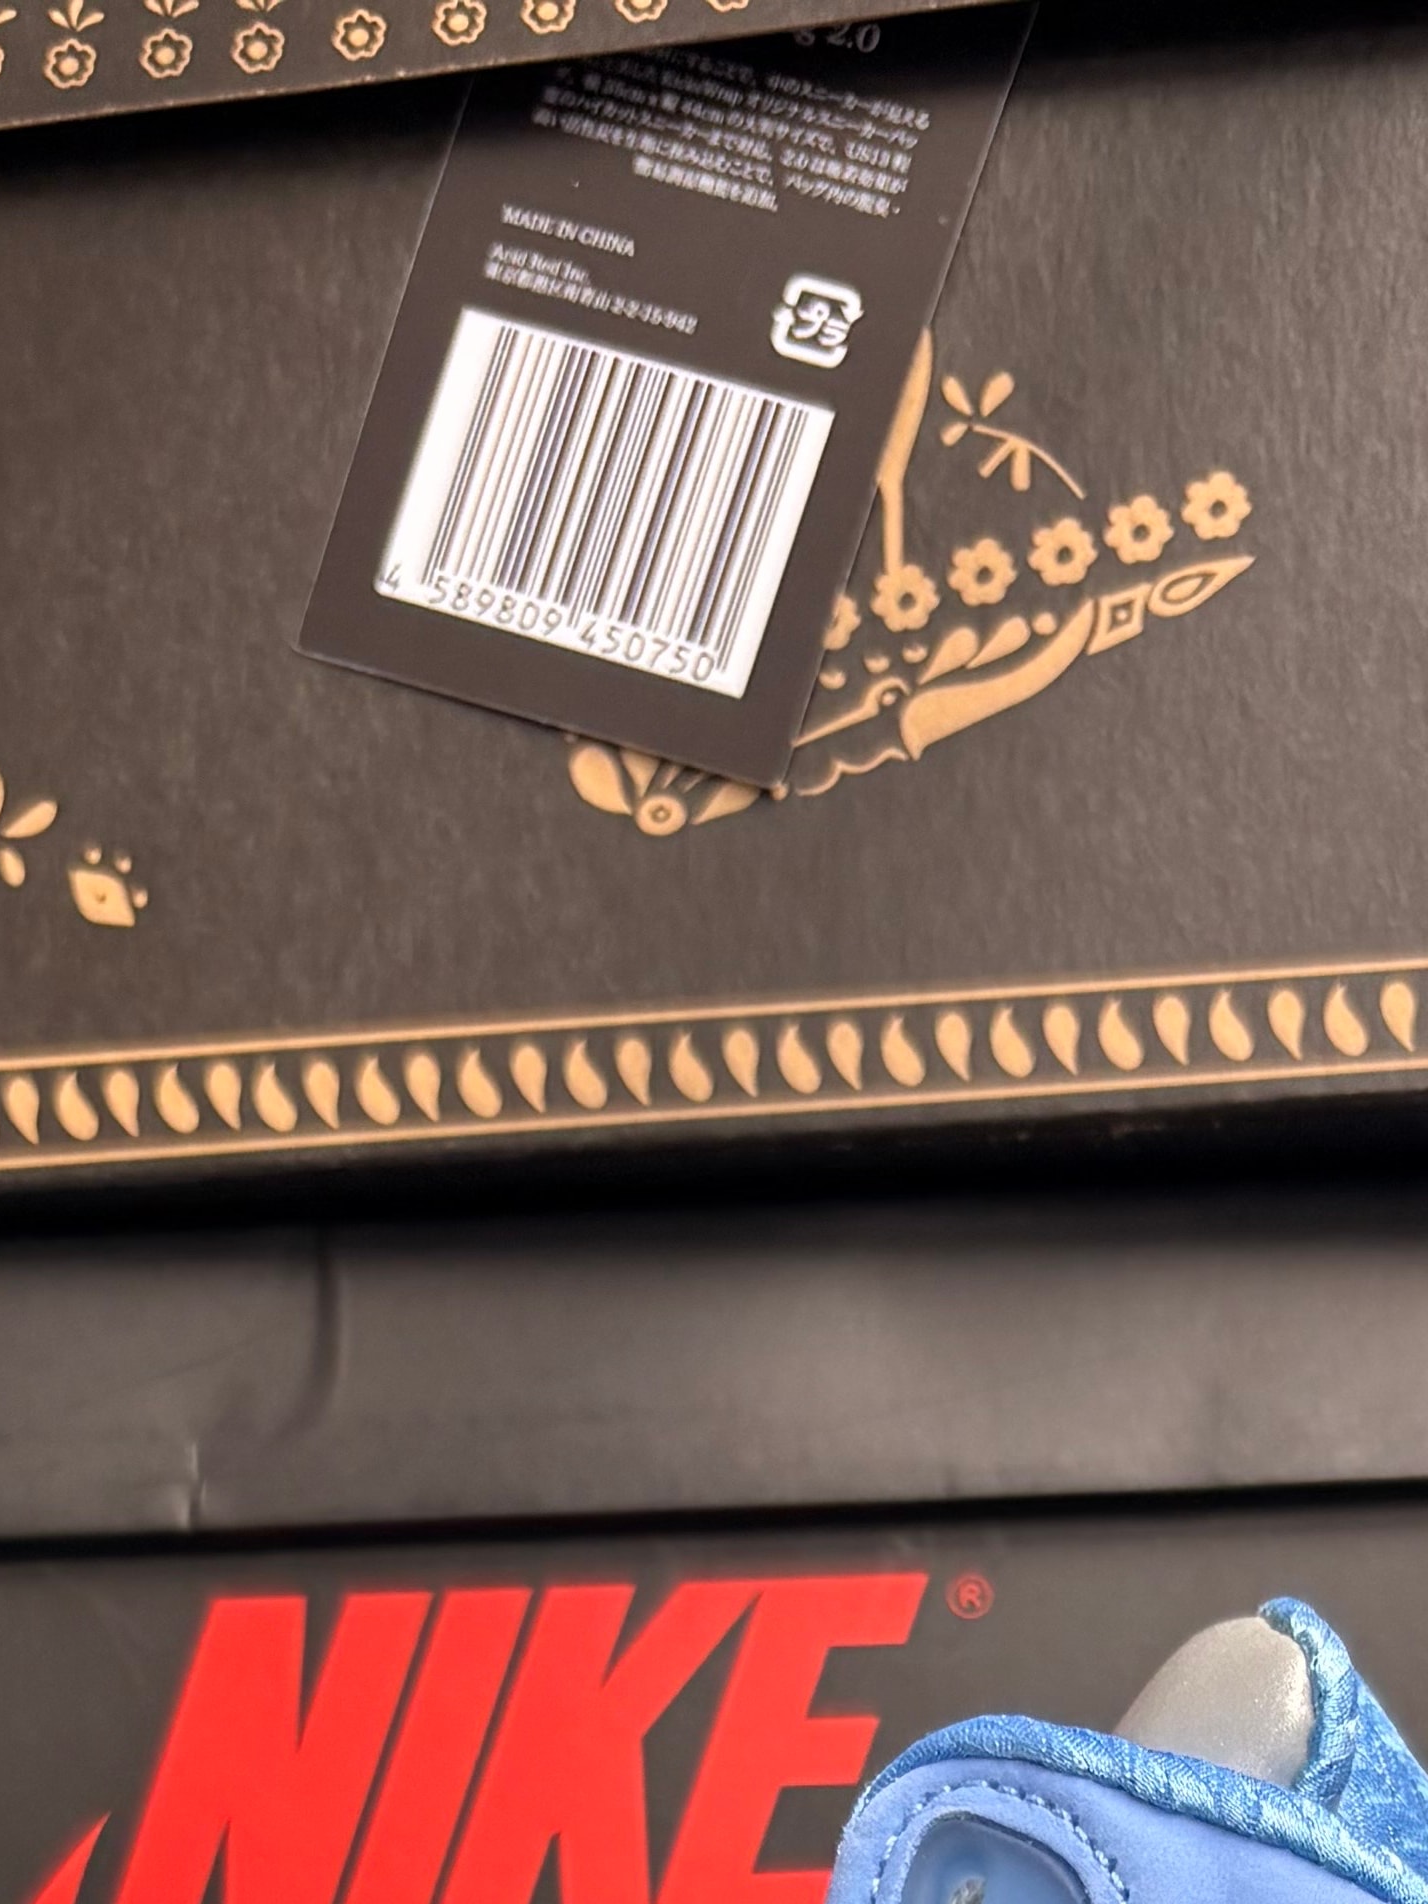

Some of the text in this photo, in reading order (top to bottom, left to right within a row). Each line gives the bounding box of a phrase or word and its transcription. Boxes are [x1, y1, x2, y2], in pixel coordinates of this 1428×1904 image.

[501, 202, 636, 257] MADE IN CHINA
[380, 562, 716, 682] 4 589809 450750
